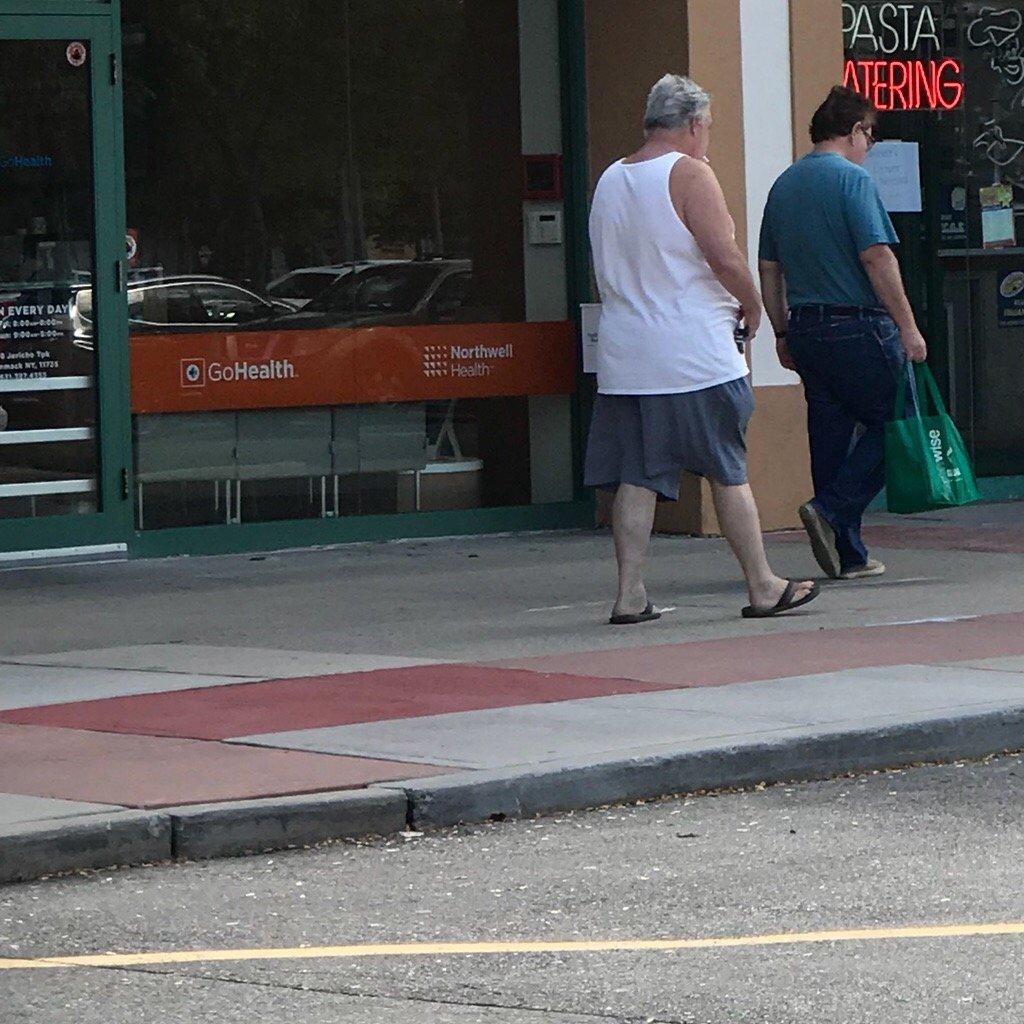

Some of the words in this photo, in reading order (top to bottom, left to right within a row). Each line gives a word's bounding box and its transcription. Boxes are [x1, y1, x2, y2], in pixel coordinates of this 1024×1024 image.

[842, 2, 941, 54] PASTA
[8, 305, 44, 316] EVERY
[47, 304, 69, 314] DAY
[450, 343, 513, 361] Northwell
[207, 359, 294, 382] GoHealth
[450, 362, 488, 378] Health
[929, 429, 944, 464] wise
